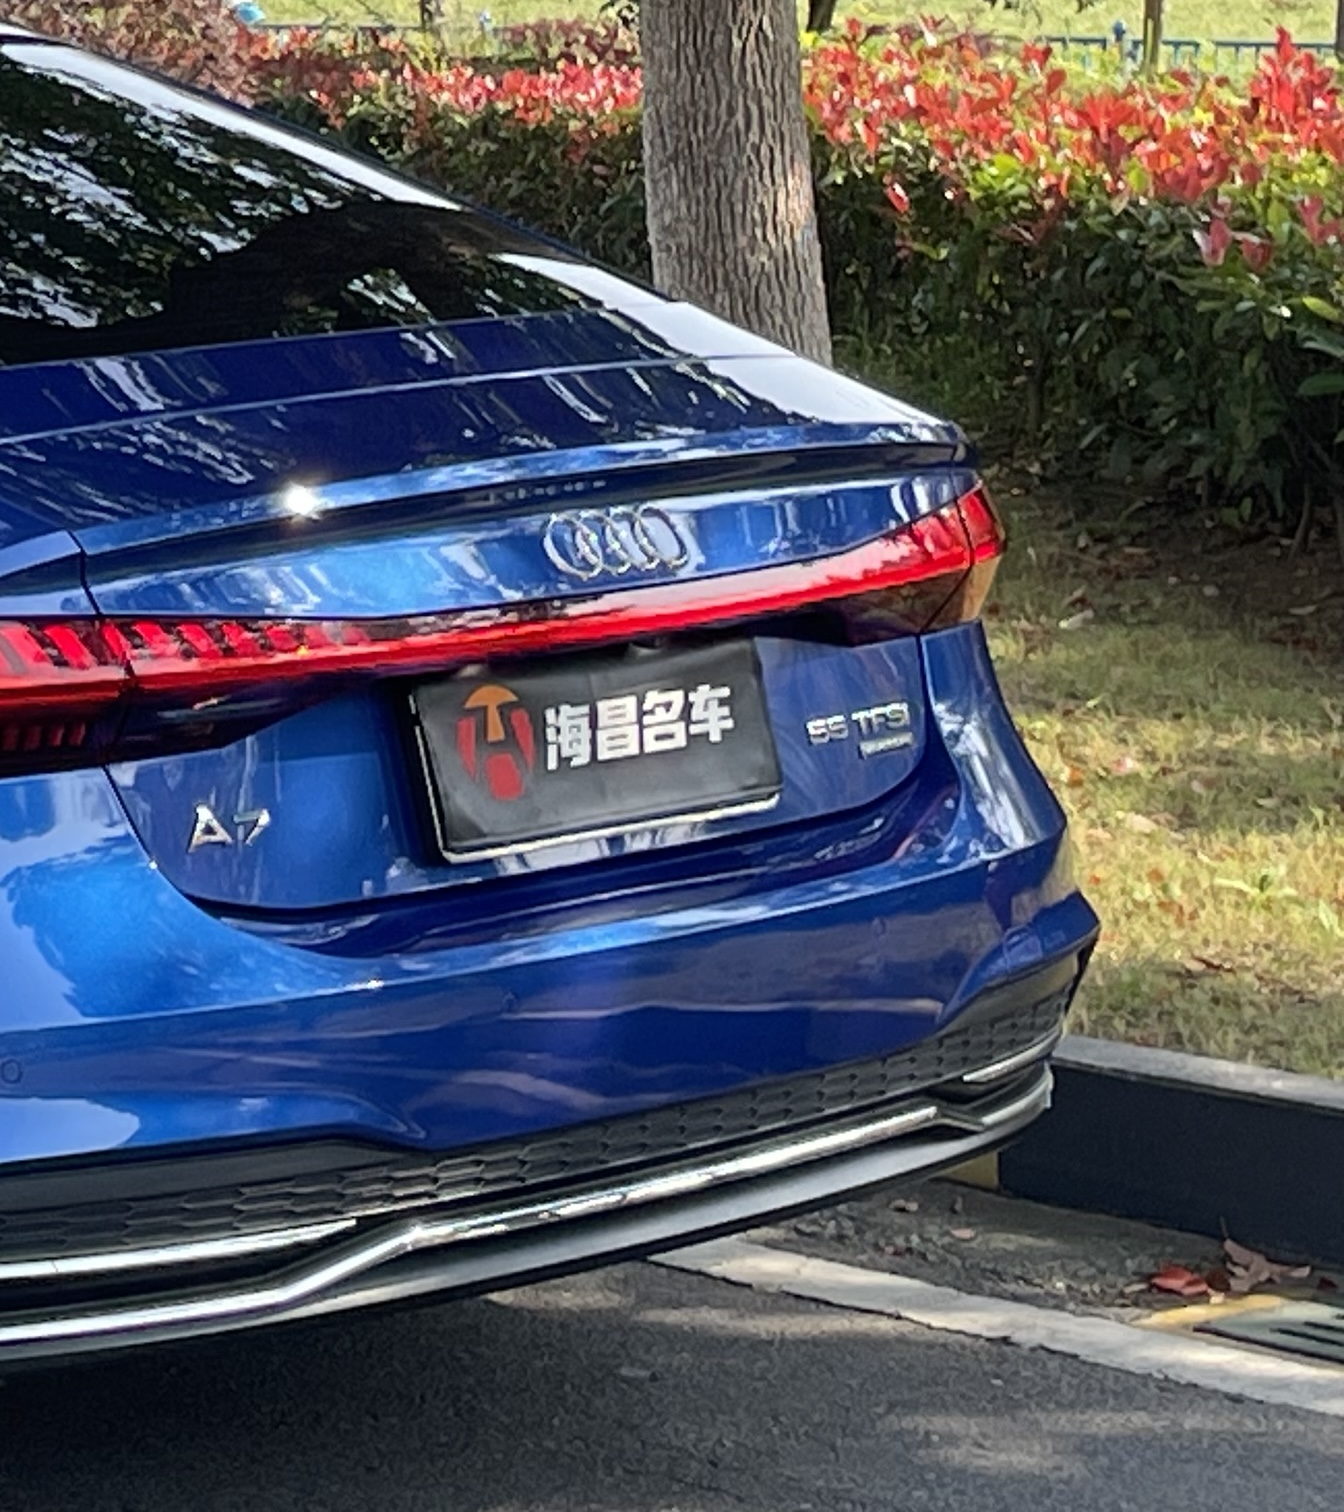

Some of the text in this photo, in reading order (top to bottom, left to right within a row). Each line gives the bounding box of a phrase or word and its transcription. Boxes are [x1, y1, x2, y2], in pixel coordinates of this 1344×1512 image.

[544, 683, 735, 771] 海昌名车
[805, 714, 848, 745] 55
